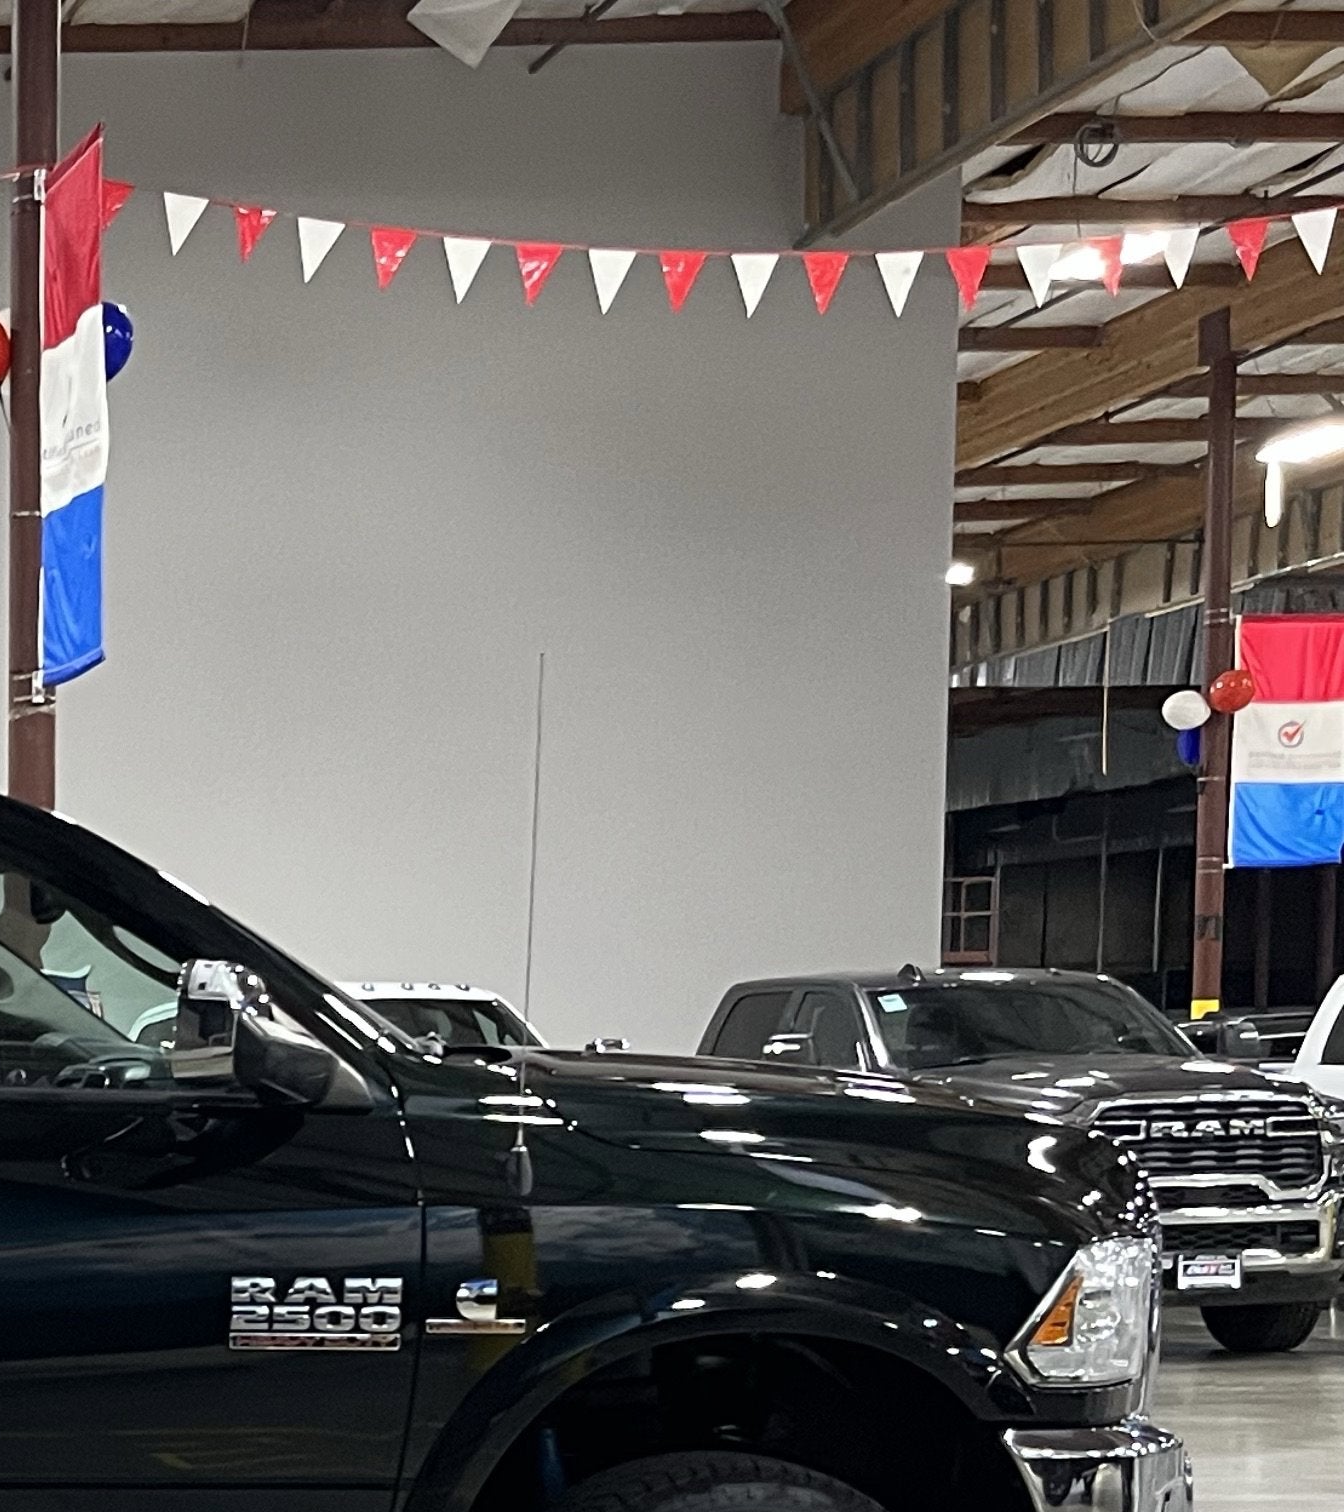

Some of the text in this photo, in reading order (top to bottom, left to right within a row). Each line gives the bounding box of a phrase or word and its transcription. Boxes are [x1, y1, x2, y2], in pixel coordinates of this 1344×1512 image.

[1149, 1118, 1266, 1138] RAM
[230, 1276, 404, 1304] RAM
[229, 1305, 402, 1332] 2500
